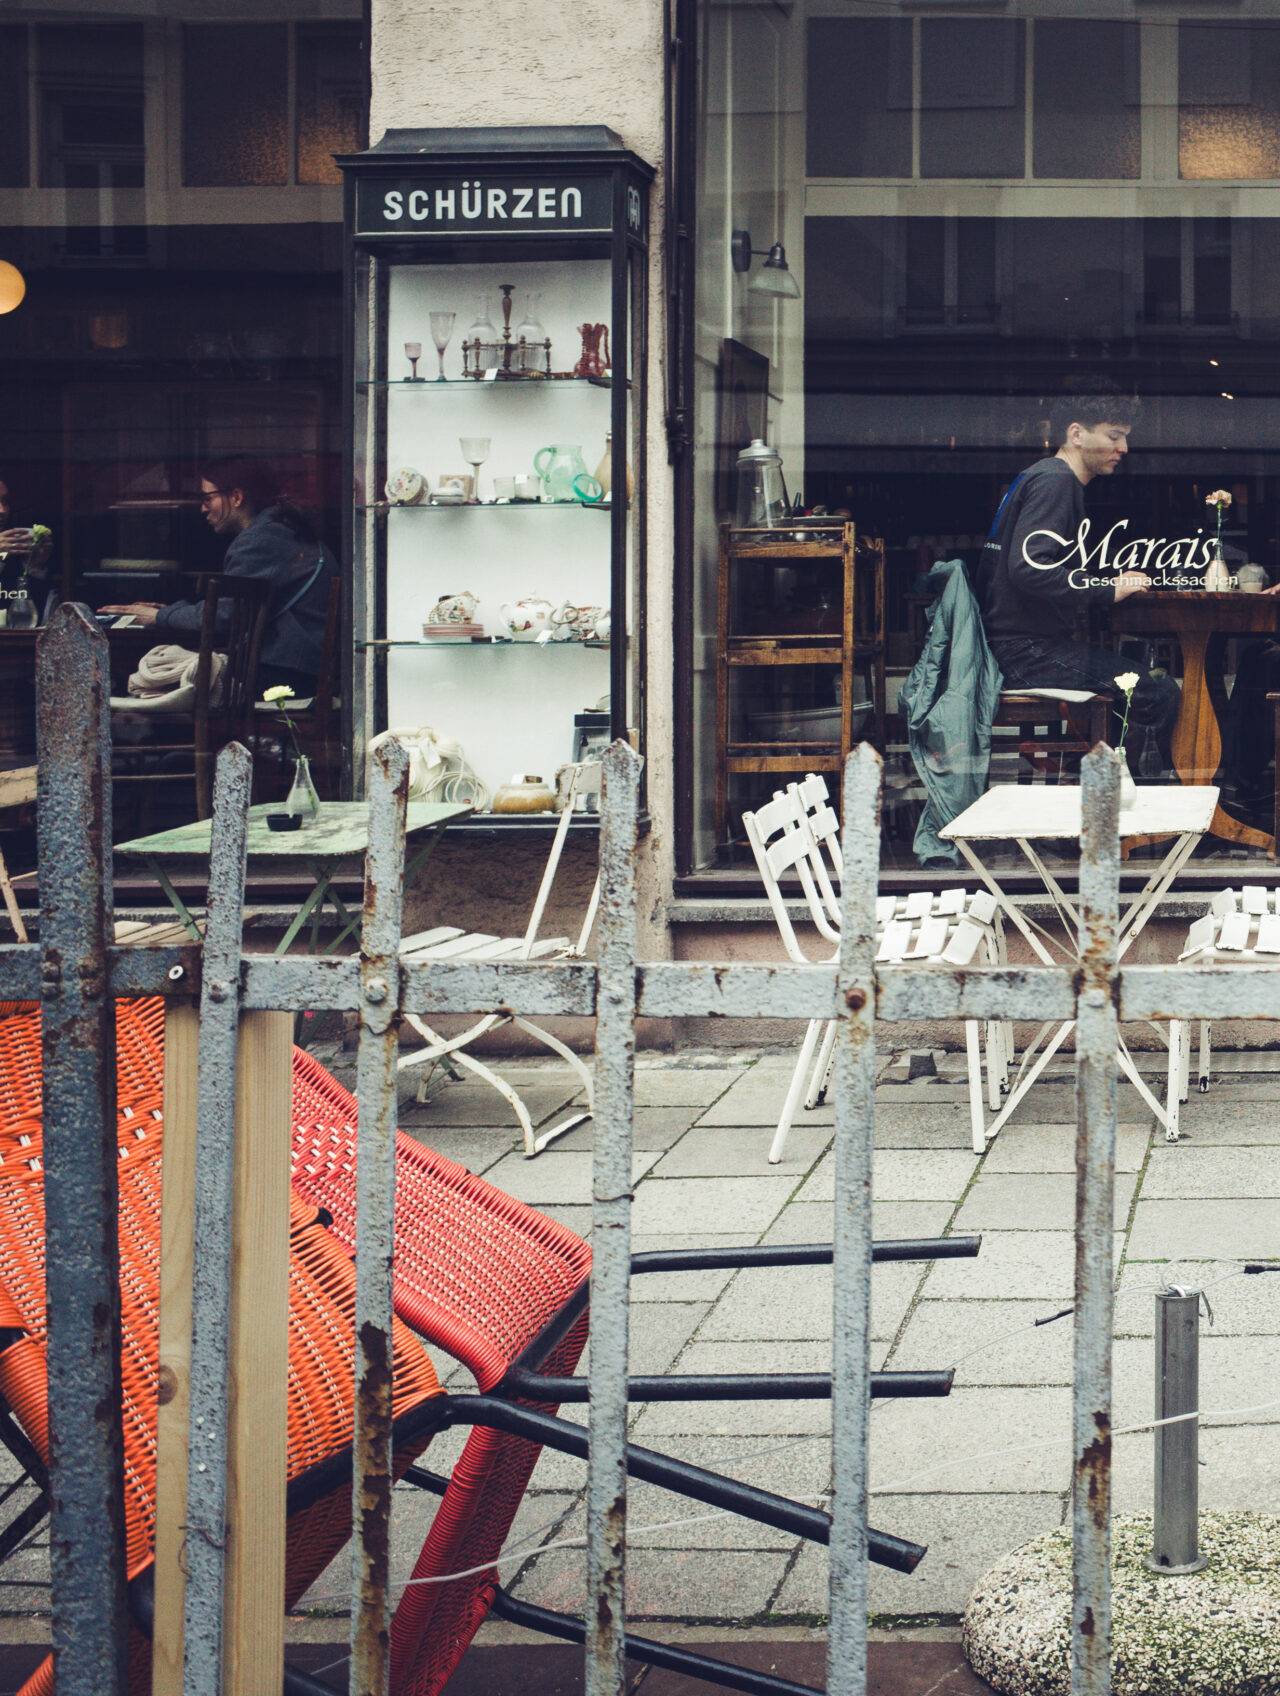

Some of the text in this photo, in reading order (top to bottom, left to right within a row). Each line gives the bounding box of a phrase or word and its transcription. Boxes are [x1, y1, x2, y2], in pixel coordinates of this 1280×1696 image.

[383, 181, 582, 220] SCHÜRZEN
[1022, 518, 1218, 570] Marais
[1067, 568, 1238, 589] Geschmackssachen
